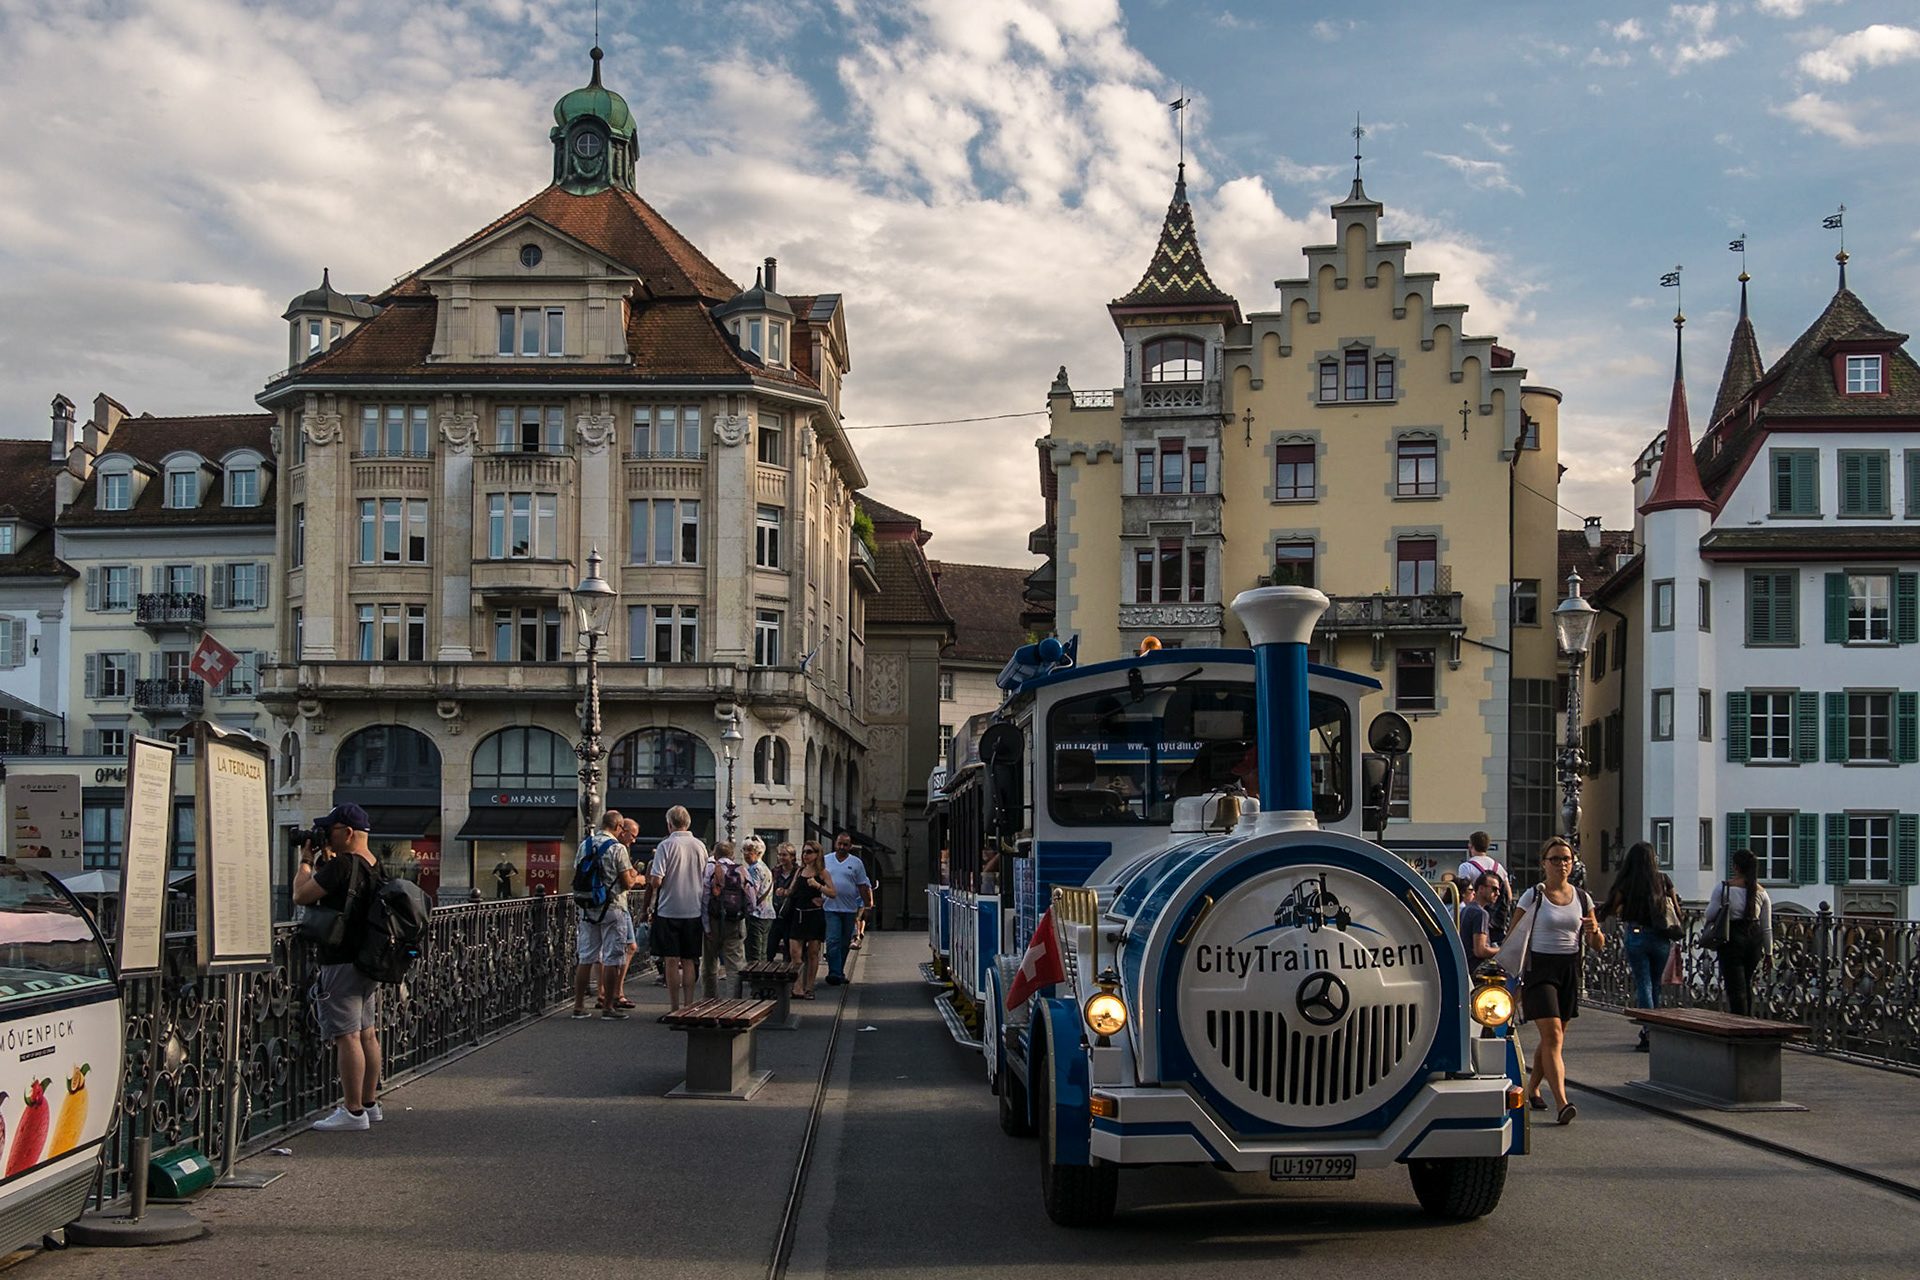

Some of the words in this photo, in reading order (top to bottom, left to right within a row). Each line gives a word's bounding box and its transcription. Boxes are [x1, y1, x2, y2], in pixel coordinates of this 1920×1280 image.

[217, 756, 227, 772] LA
[228, 758, 262, 781] TERRAZZA
[491, 794, 557, 804] COMPANYS
[416, 851, 441, 860] SALE
[530, 853, 556, 863] SALE
[530, 869, 555, 879] 50%
[1196, 942, 1329, 979] CityTrain
[1339, 942, 1424, 970] Luzern
